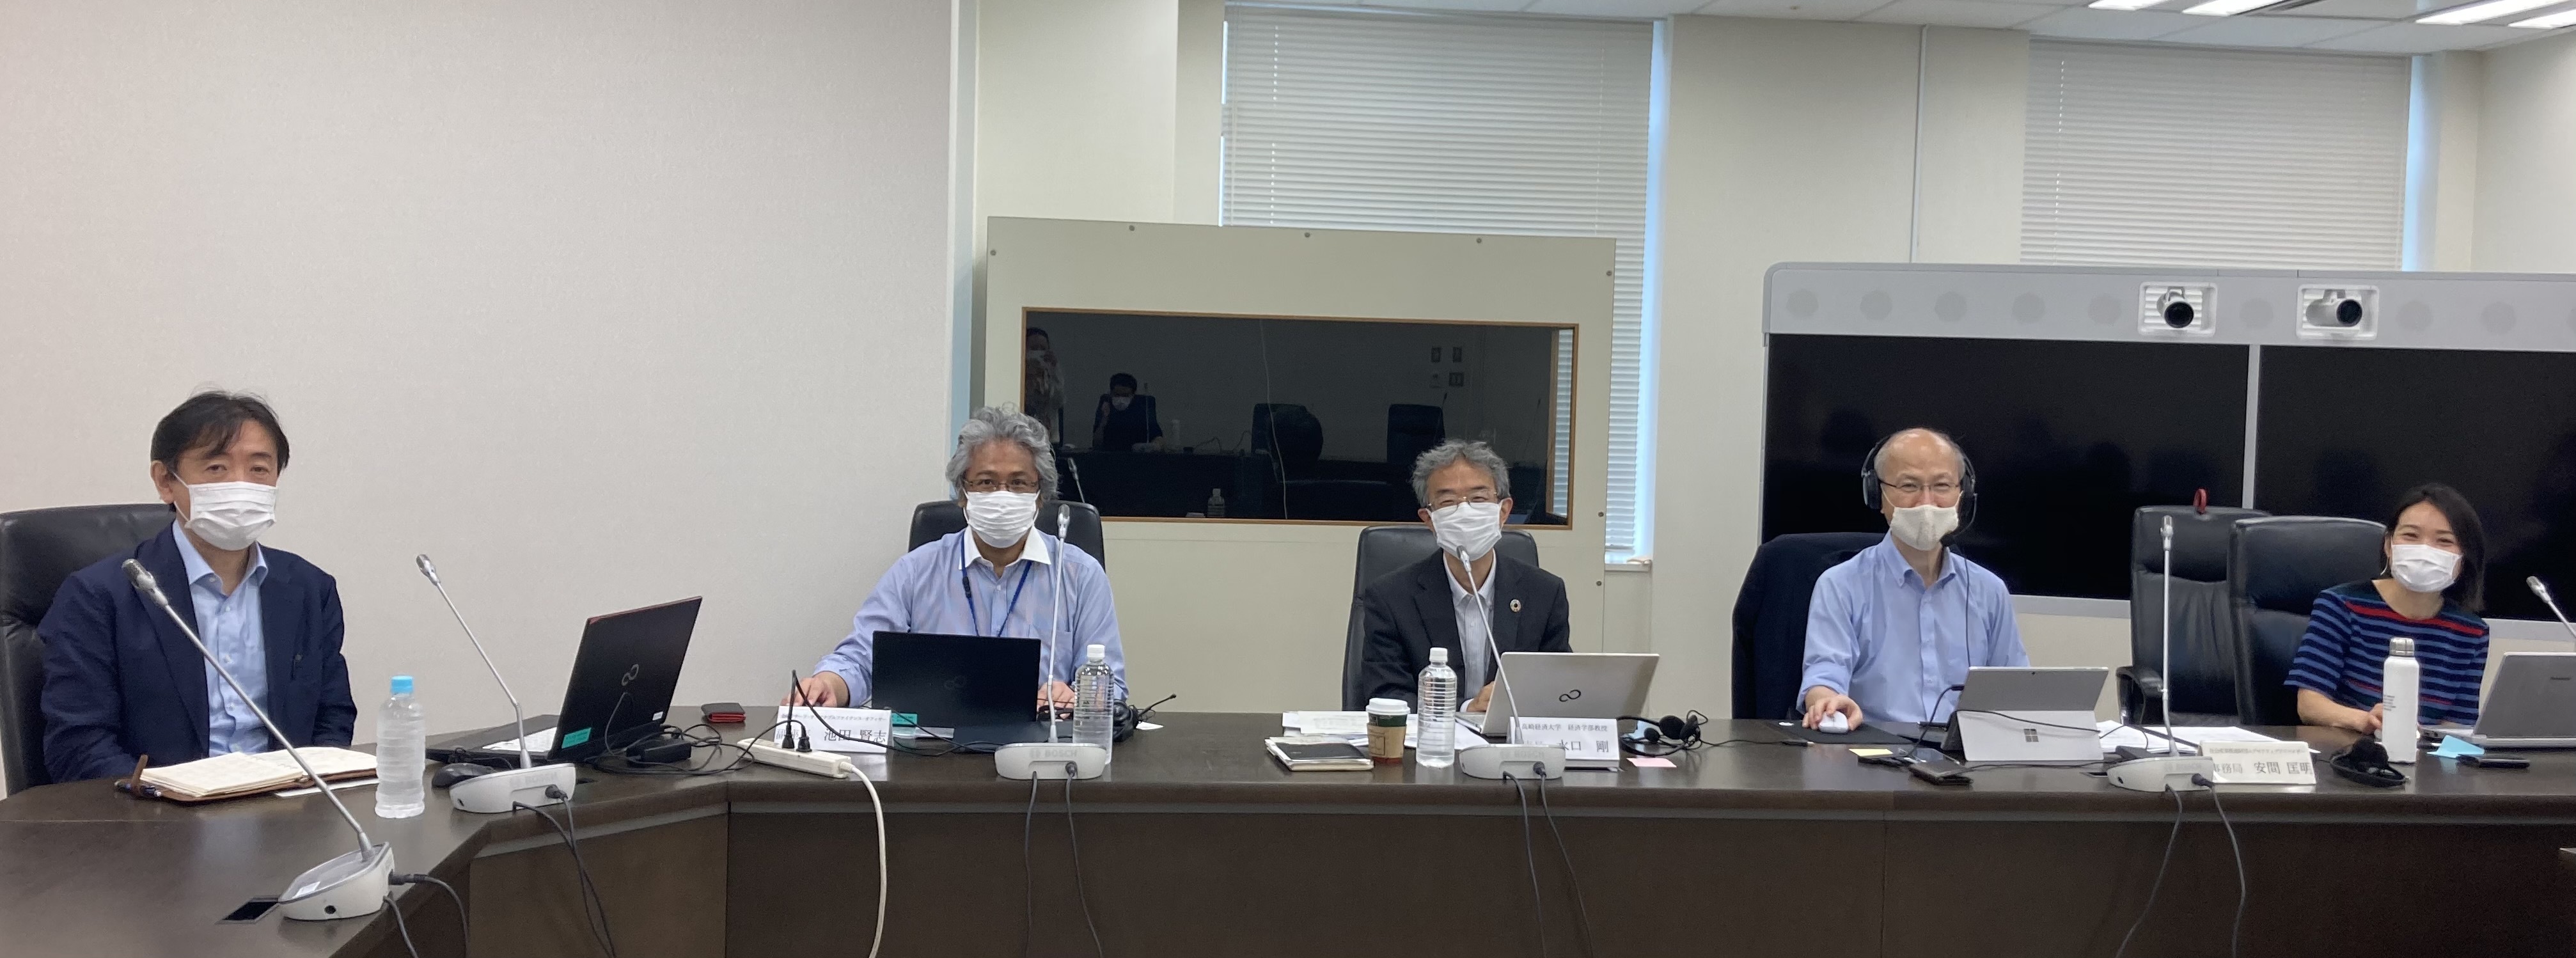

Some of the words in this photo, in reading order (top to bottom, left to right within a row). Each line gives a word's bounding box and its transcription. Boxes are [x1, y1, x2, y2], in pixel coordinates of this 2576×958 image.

[1522, 723, 1561, 731] 高崎経済大学
[1567, 724, 1608, 732] 経済学部教授
[824, 728, 851, 741] 池田
[860, 730, 886, 743] 賢志
[1557, 739, 1582, 751] 水口
[1596, 740, 1609, 753] 剛
[1045, 750, 1077, 758] BOSCH
